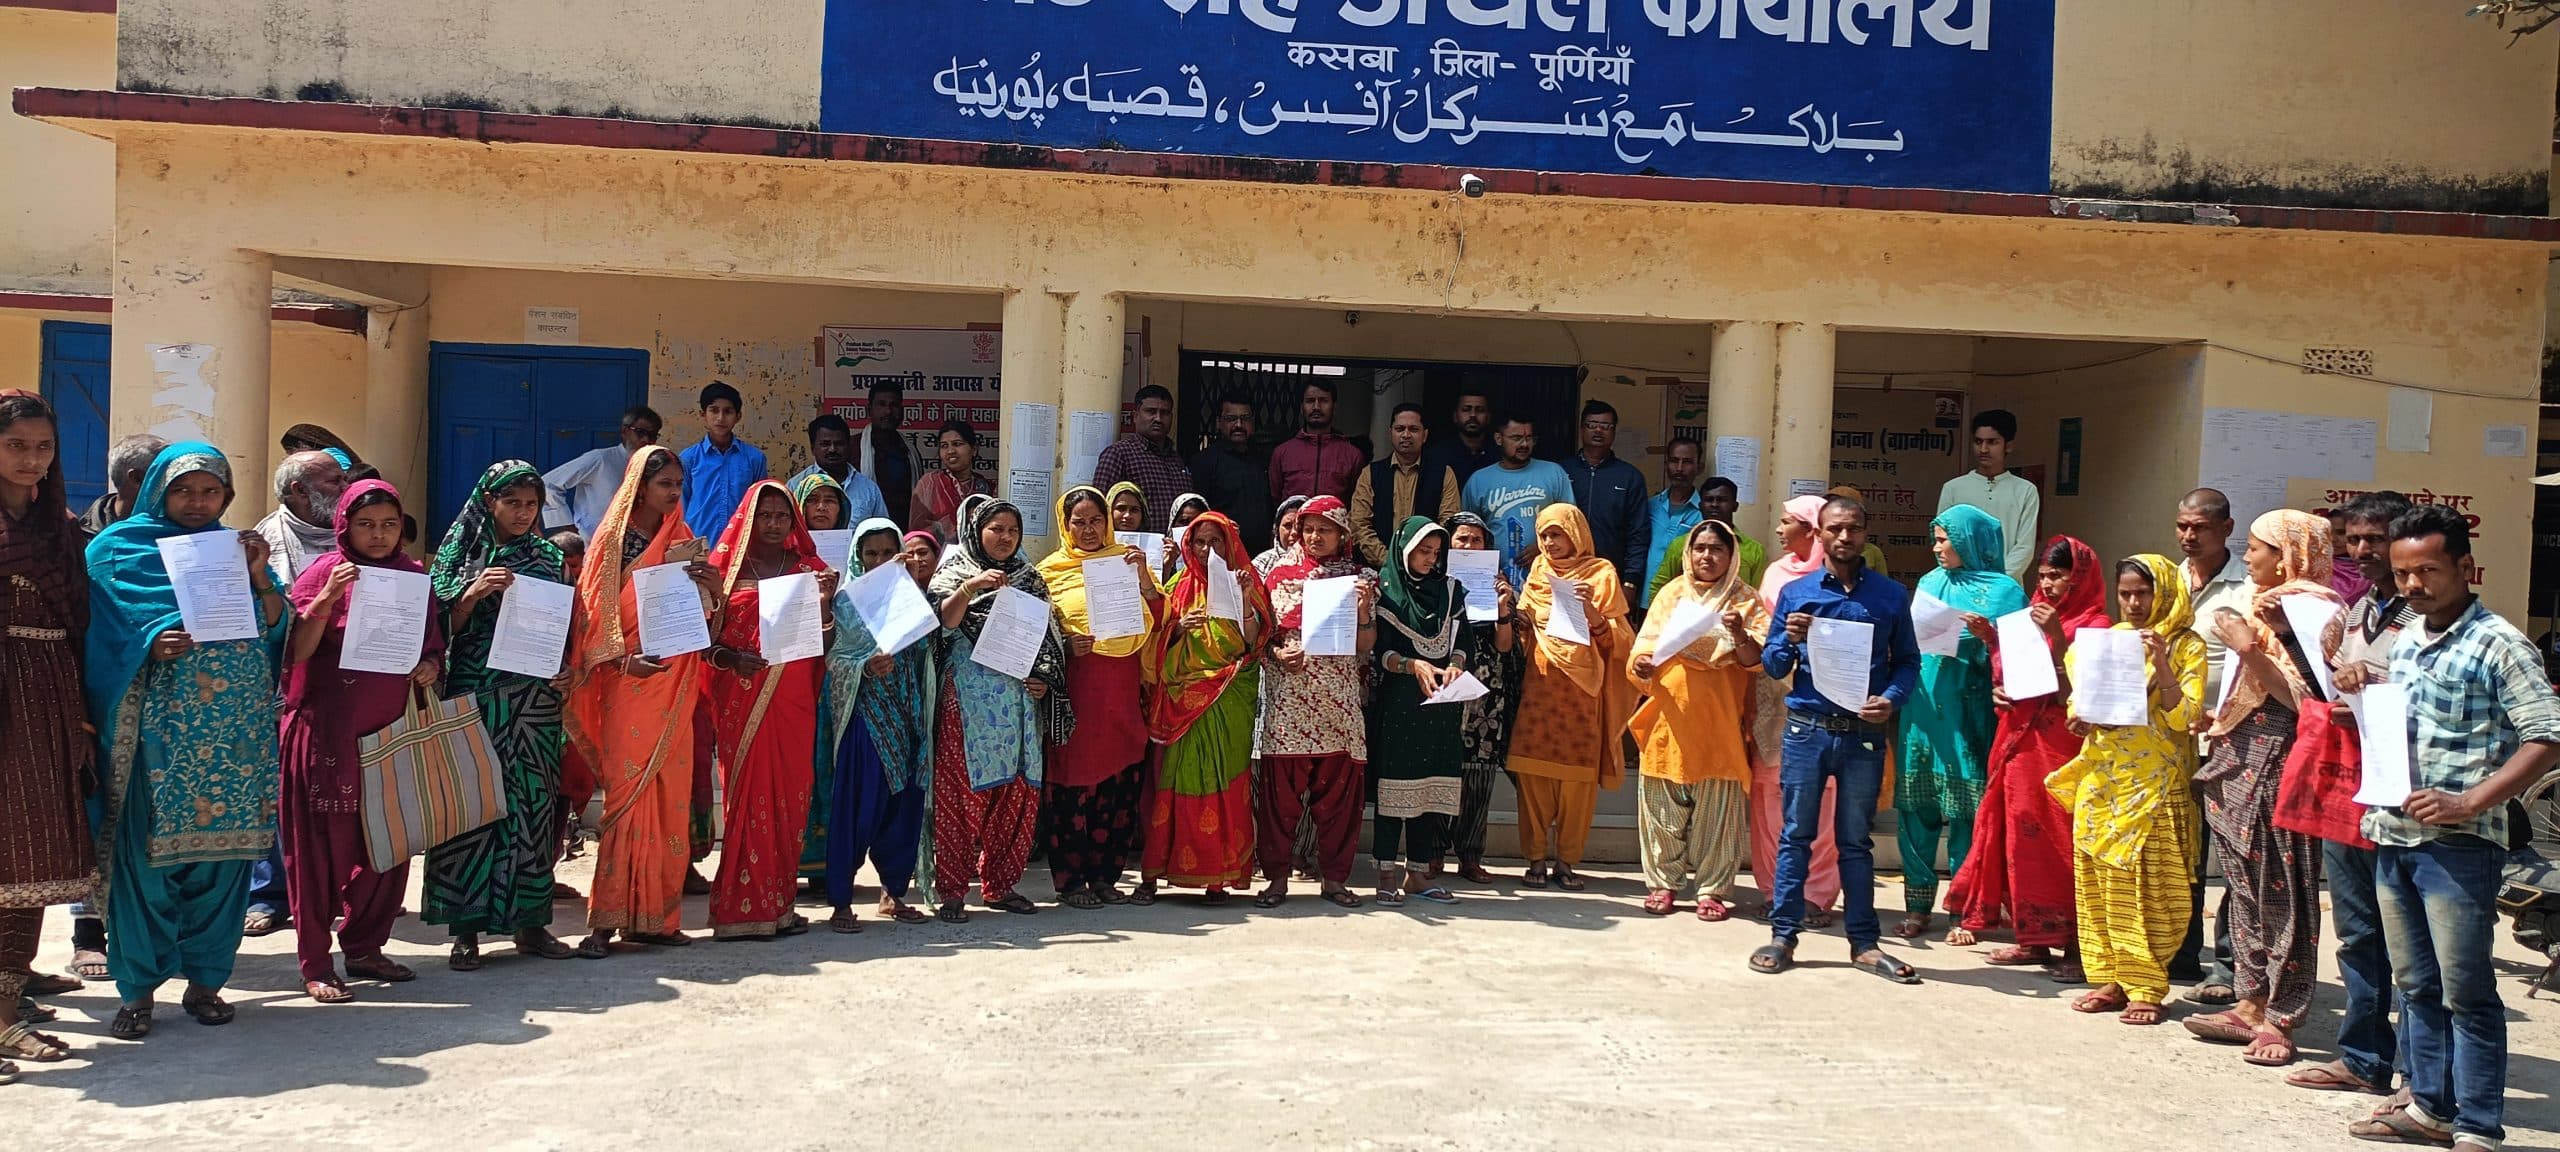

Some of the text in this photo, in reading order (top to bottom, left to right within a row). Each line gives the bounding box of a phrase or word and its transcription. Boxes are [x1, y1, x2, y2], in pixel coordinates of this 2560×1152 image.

[1286, 41, 1400, 73] कसबा
[1528, 44, 1636, 94] पूर्णियाँ
[932, 374, 985, 392] आवास
[927, 402, 940, 421] के
[943, 402, 968, 422] लिए
[1881, 427, 1954, 457] (ग्रामीण)
